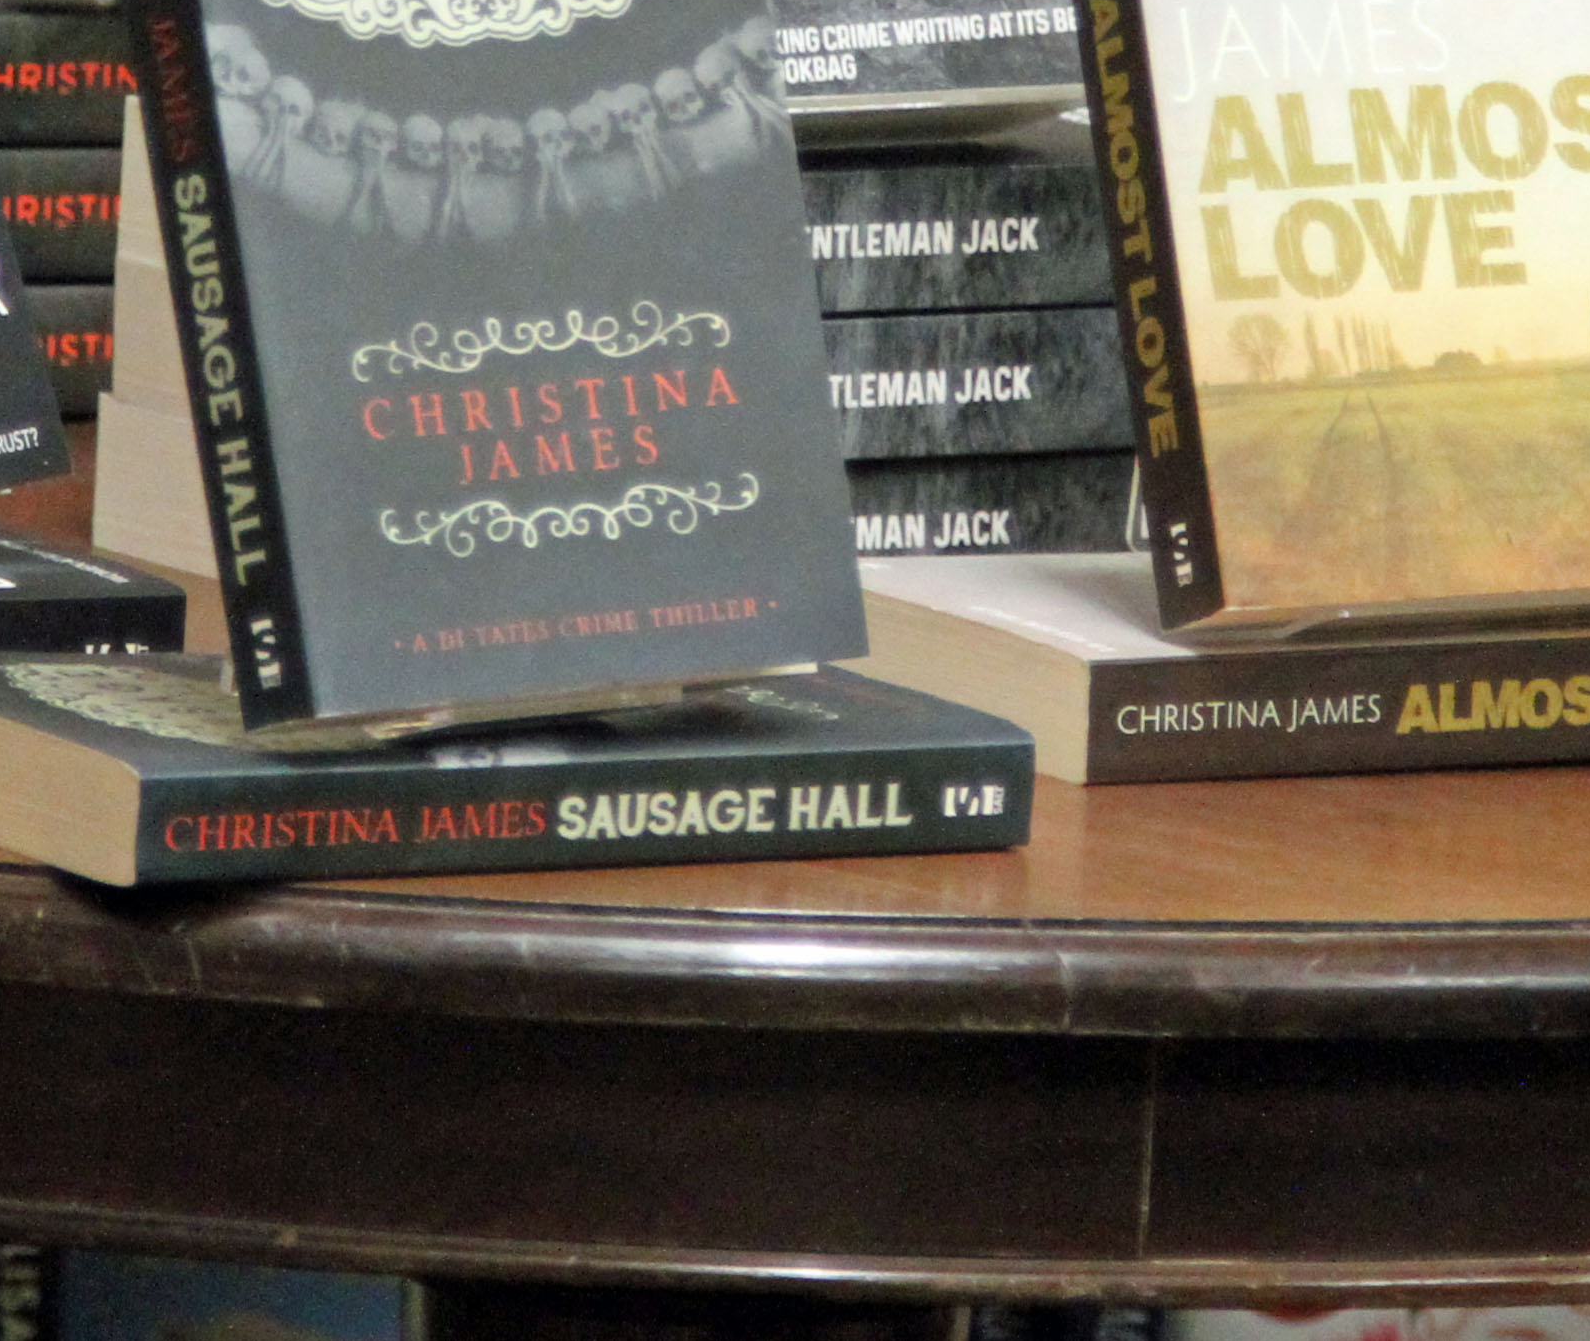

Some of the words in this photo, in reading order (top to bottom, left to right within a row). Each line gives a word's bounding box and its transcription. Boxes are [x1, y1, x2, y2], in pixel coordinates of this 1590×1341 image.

[821, 21, 892, 51] CRIME
[891, 14, 986, 46] WRITING
[988, 13, 1015, 39] AT
[1016, 10, 1051, 35] ITS
[961, 216, 1040, 256] JACK
[1199, 188, 1529, 303] LOVE
[173, 173, 244, 428] SAUSAGE
[216, 439, 268, 587] HALL
[954, 364, 1033, 404] JACK
[1126, 276, 1181, 460] LOVE
[361, 365, 740, 441] CHRISTINA
[458, 425, 660, 486] JAMES
[933, 509, 1011, 551] JACK
[1115, 698, 1282, 737] CHRISTINA
[1286, 693, 1383, 734] JAMES
[163, 807, 400, 854] CHRISTINA
[414, 800, 548, 844] JAMES
[556, 788, 777, 842] SAUSAGE
[787, 782, 913, 831] HALL
